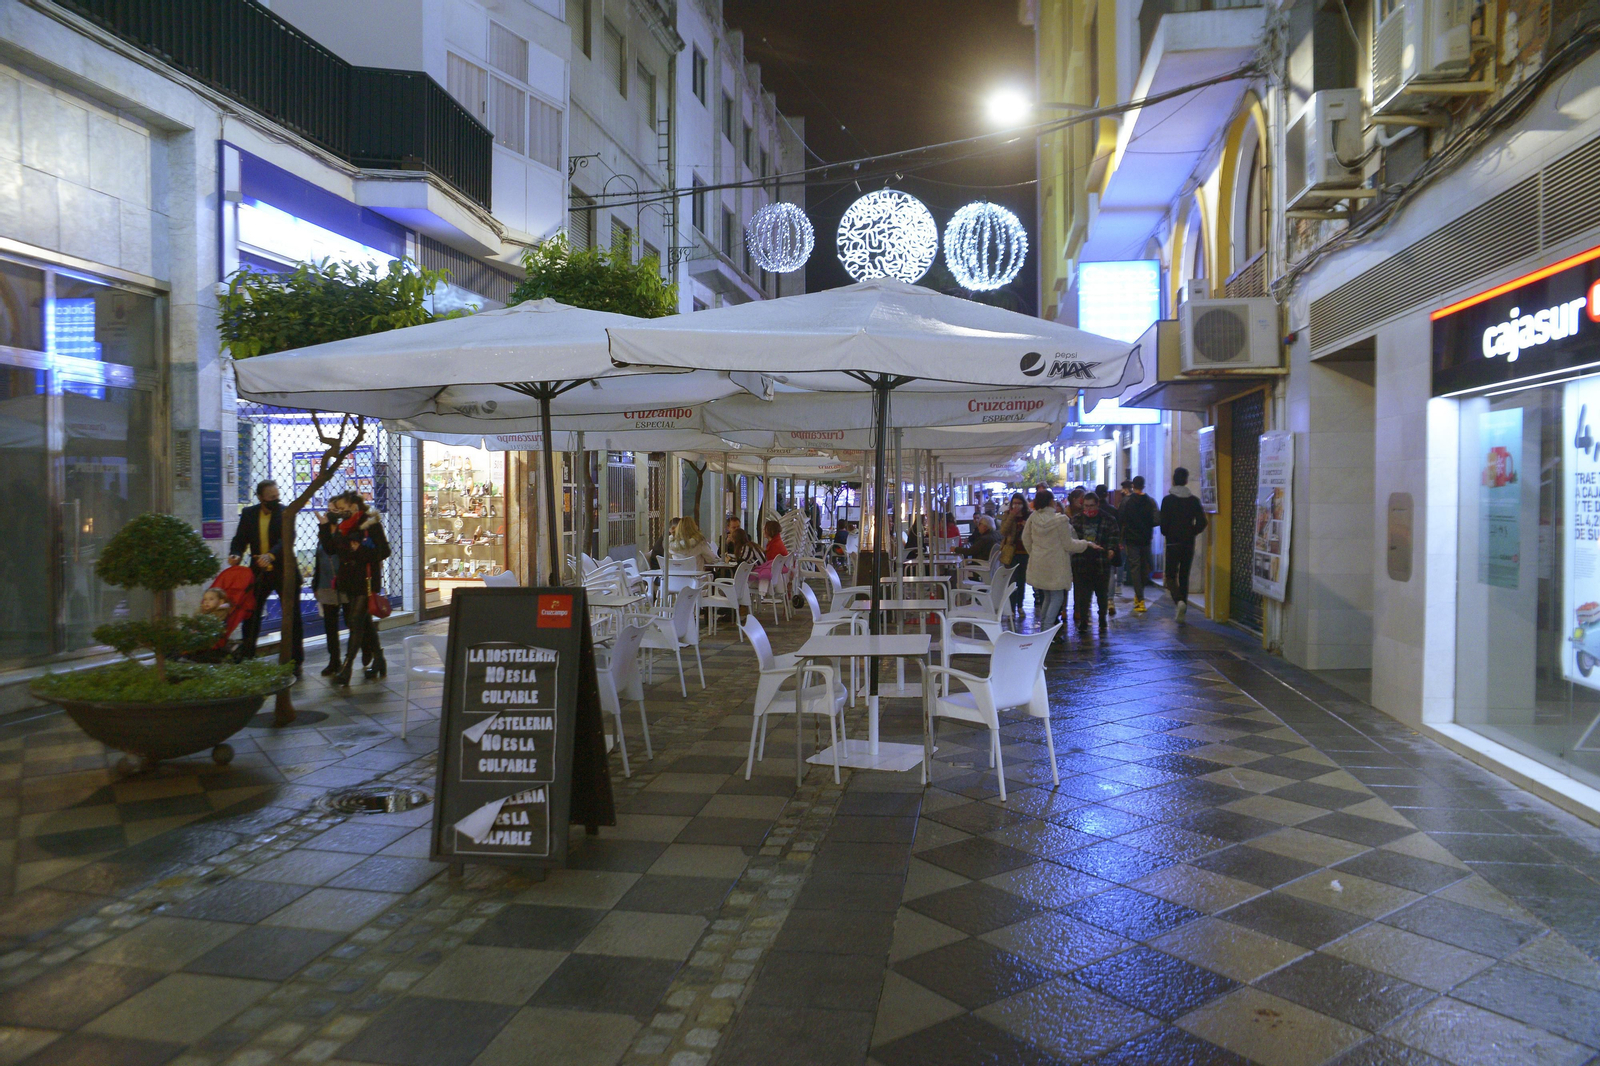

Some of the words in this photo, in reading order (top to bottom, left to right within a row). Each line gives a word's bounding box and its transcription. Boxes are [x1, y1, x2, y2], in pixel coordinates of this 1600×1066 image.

[1482, 296, 1587, 363] cajasur
[1047, 360, 1102, 379] MAX
[968, 398, 1045, 412] Cruzcampo
[635, 421, 675, 429] ESPECIAL
[982, 413, 1025, 423] ESPECIAL
[1575, 472, 1596, 485] TRAE
[1575, 487, 1581, 498] A
[1582, 500, 1593, 512] TE
[1575, 514, 1584, 526] EL
[1575, 528, 1585, 540] DE
[469, 649, 485, 662] LA
[486, 649, 556, 662] HOSTELERIA
[485, 666, 505, 683] NO
[506, 669, 520, 683] ES
[521, 669, 537, 683] LA
[482, 690, 539, 704] CULPABLE
[490, 716, 553, 731] OSTELERIA
[481, 734, 502, 751] NO
[503, 737, 518, 751] ES
[519, 737, 535, 751] LA
[479, 758, 538, 773] CULPABLE
[512, 810, 529, 825] LA
